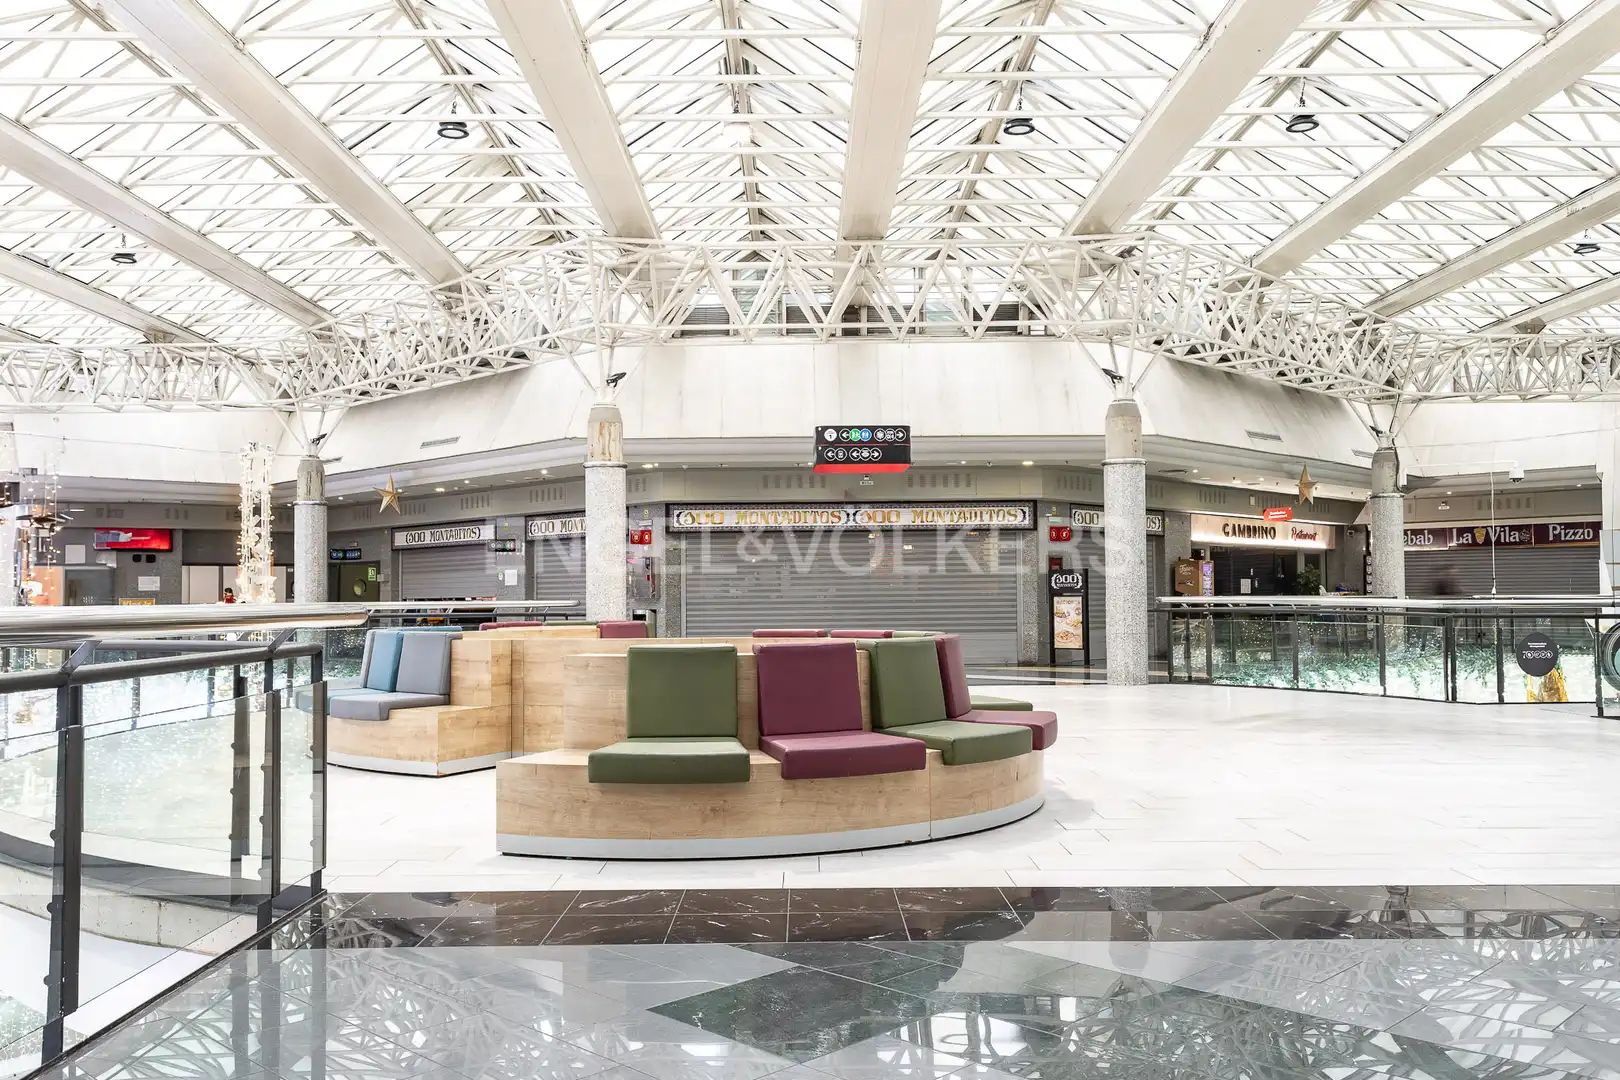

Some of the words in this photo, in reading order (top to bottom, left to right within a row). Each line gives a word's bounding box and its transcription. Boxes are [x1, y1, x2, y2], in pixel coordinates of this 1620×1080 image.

[735, 510, 842, 525] MONTADITOS
[911, 508, 1018, 524] MONTADITOS
[560, 518, 586, 532] MONT
[1222, 523, 1276, 540] GAMBRINO
[1548, 524, 1593, 541] Pizzo
[429, 527, 477, 542] MONTADITOS
[1403, 529, 1433, 546] ebab
[1452, 528, 1472, 544] La
[1487, 526, 1520, 543] Vila
